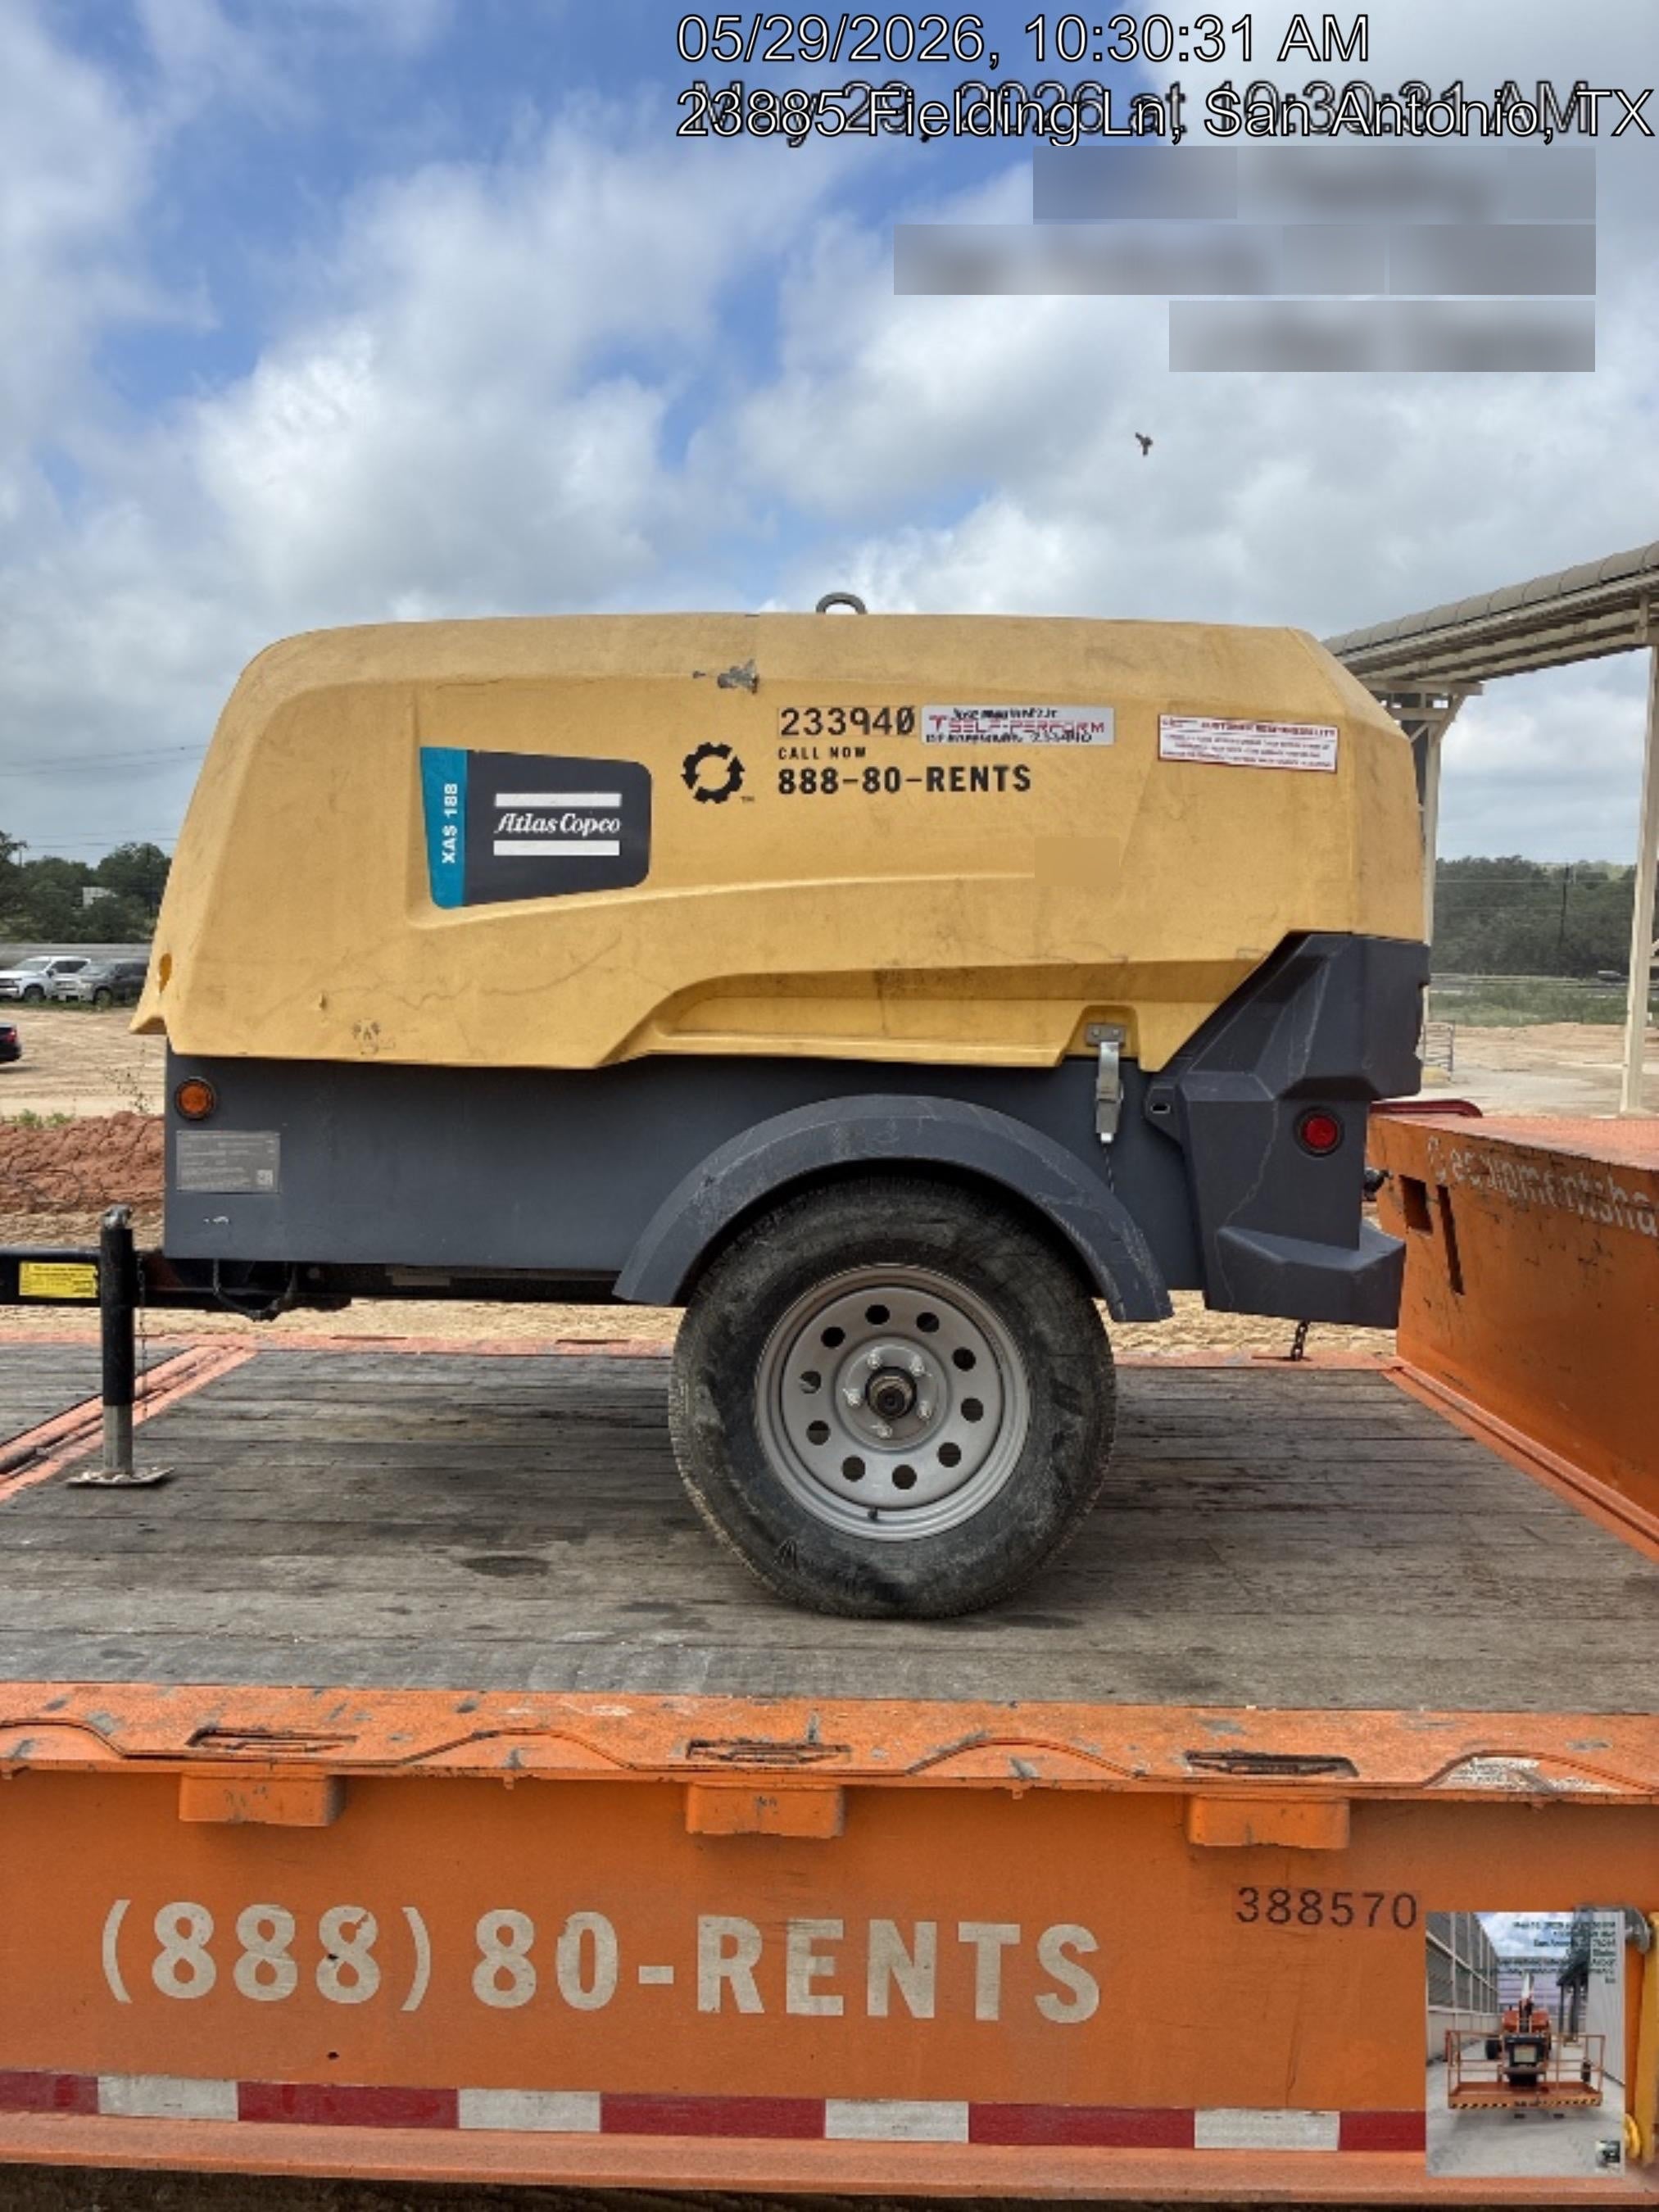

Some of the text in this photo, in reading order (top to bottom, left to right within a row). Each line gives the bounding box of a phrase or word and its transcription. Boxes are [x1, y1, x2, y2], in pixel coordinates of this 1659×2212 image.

[780, 706, 914, 736] 233940
[778, 746, 866, 760] CALL NOW
[778, 765, 1032, 795] 888-80-RENTS
[442, 824, 459, 864] XAS
[1235, 1887, 1417, 1929] 388570
[102, 1899, 1100, 2024] (888) 80-RENTS
